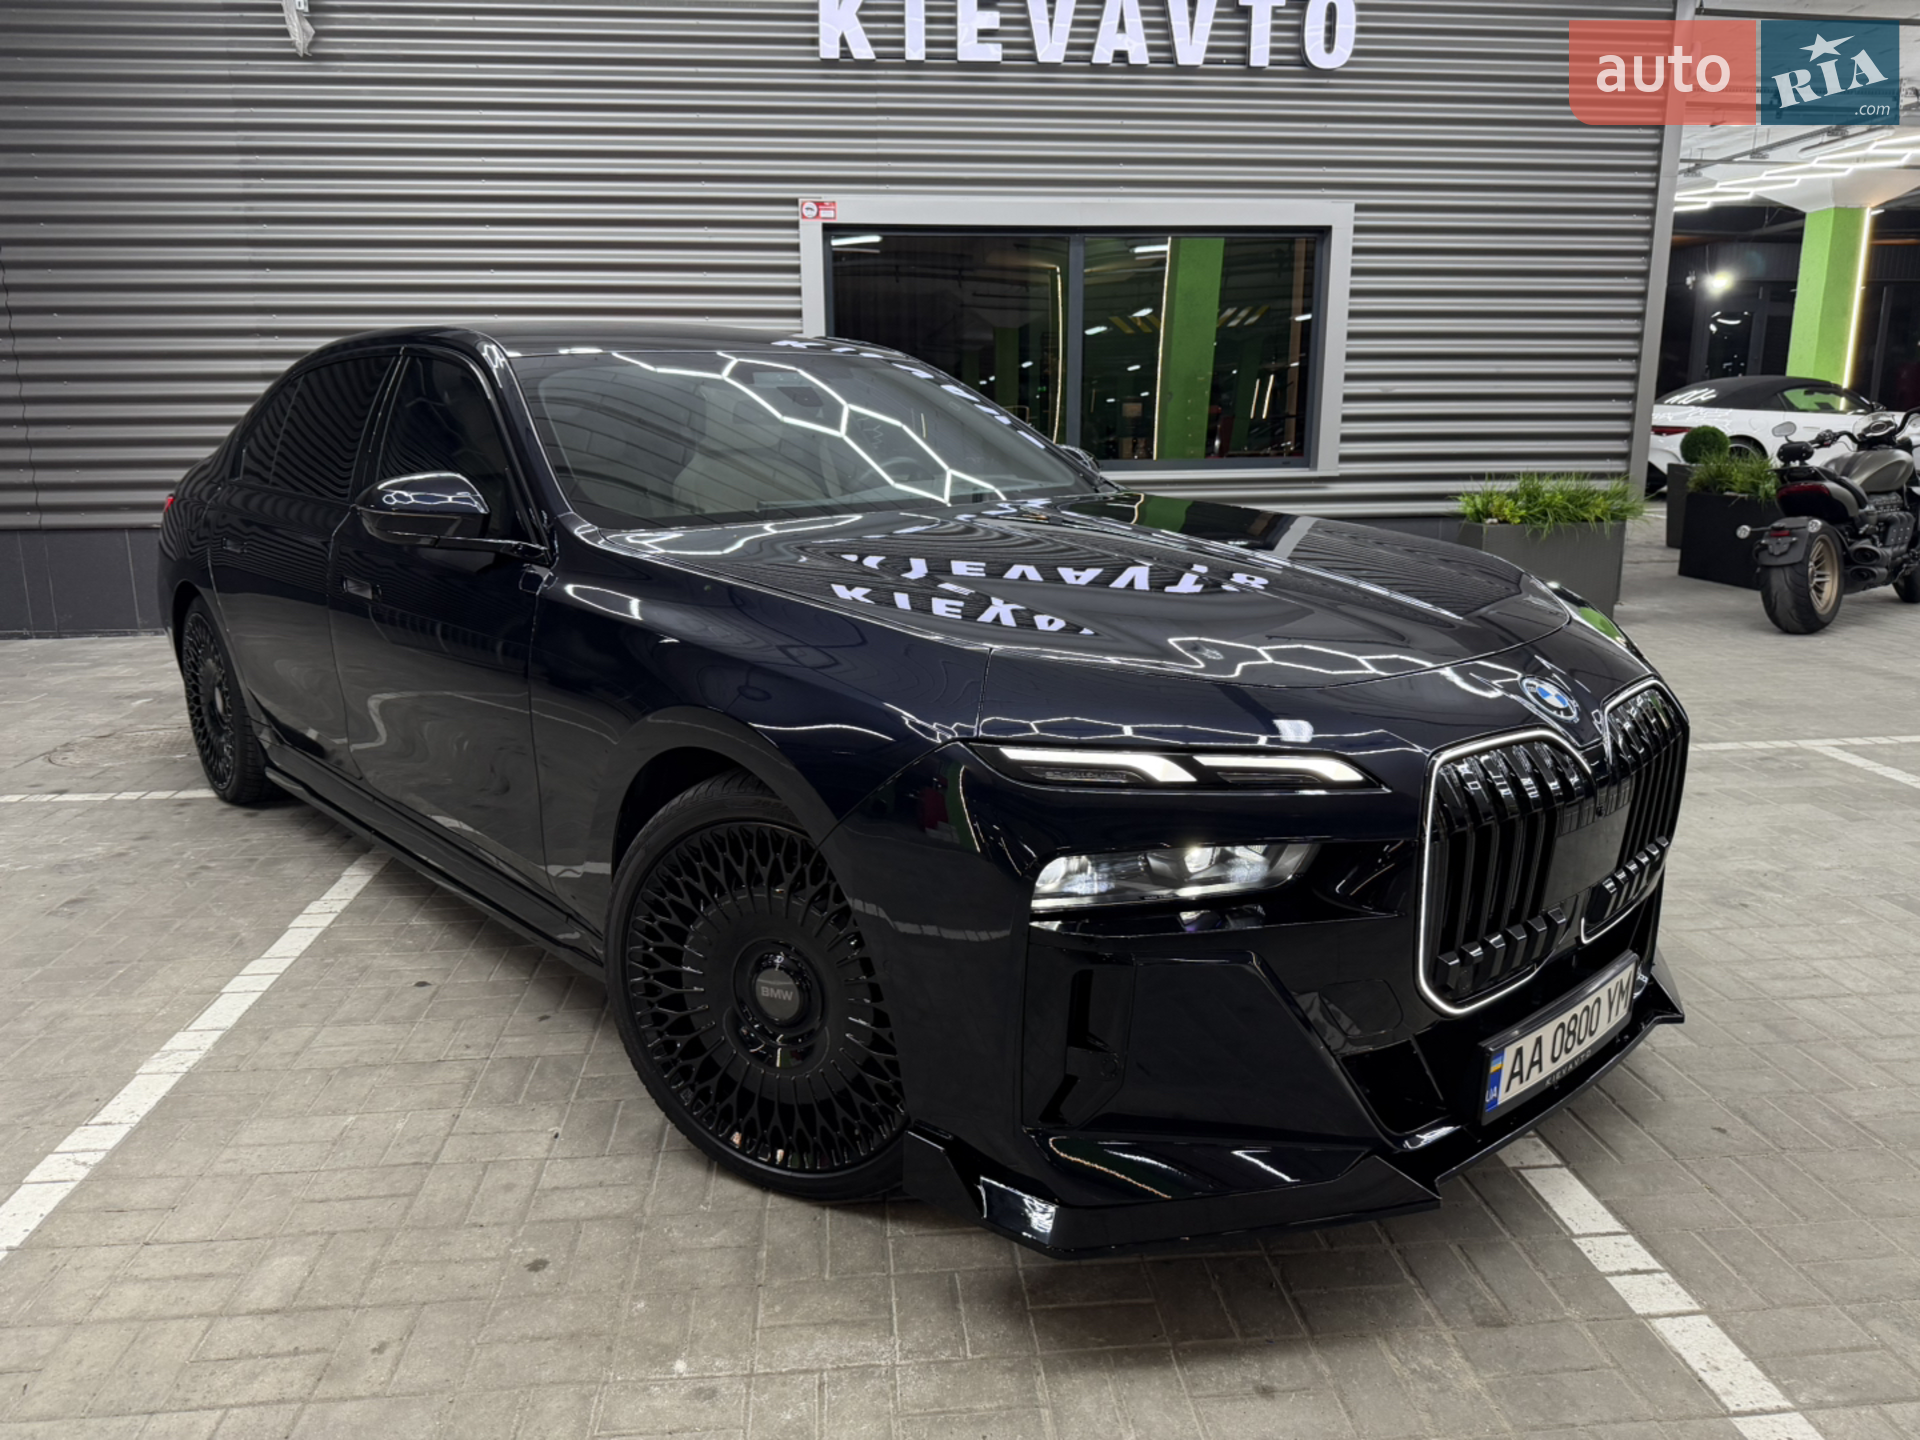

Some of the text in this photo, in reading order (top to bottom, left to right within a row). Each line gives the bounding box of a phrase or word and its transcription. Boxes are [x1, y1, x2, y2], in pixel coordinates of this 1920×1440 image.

[818, 0, 1357, 69] KIEVAVTO
[760, 985, 794, 1002] BMW
[1505, 970, 1633, 1094] AA 0800 YM
